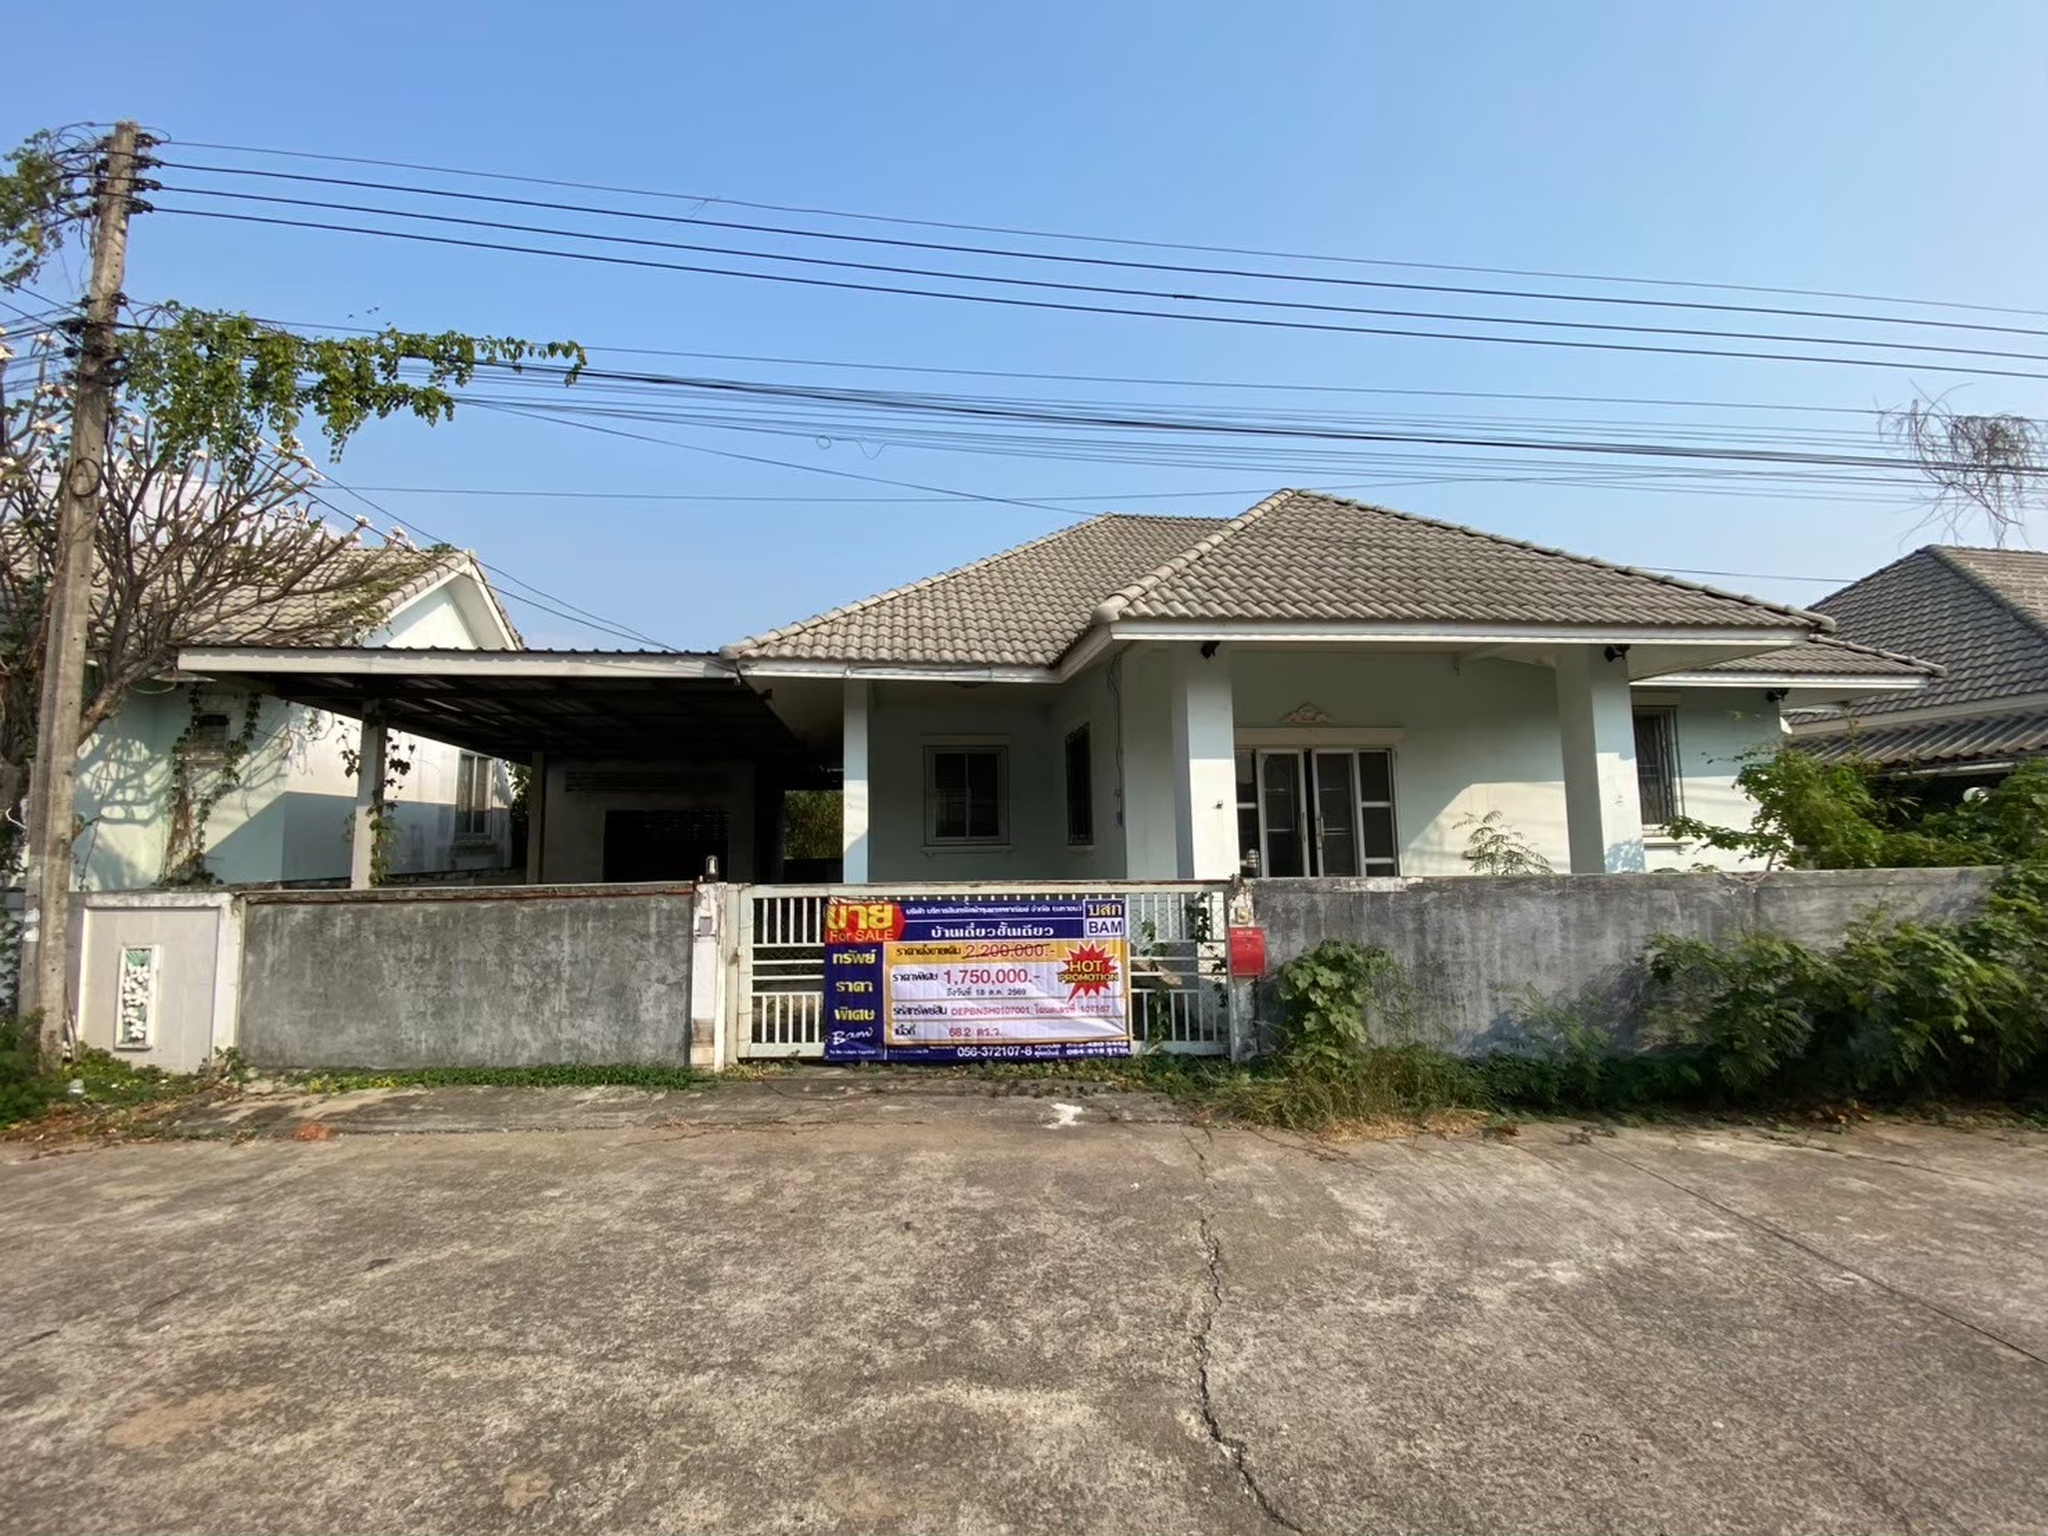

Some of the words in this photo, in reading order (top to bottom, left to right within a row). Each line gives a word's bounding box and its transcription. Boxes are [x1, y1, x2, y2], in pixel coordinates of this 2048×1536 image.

[1087, 903, 1122, 916] บสก
[826, 904, 893, 930] ขาย
[931, 922, 1054, 938] บ้านเดี่ยวชั้นเดียว
[1089, 921, 1122, 934] BAM
[829, 931, 852, 942] For
[856, 929, 894, 941] SALE
[832, 949, 877, 965] ทรัพย์
[1069, 960, 1103, 972] HOT
[1058, 973, 1118, 983] PROMOTION
[835, 981, 873, 993] ราคา
[834, 1006, 876, 1021] พิเศษ
